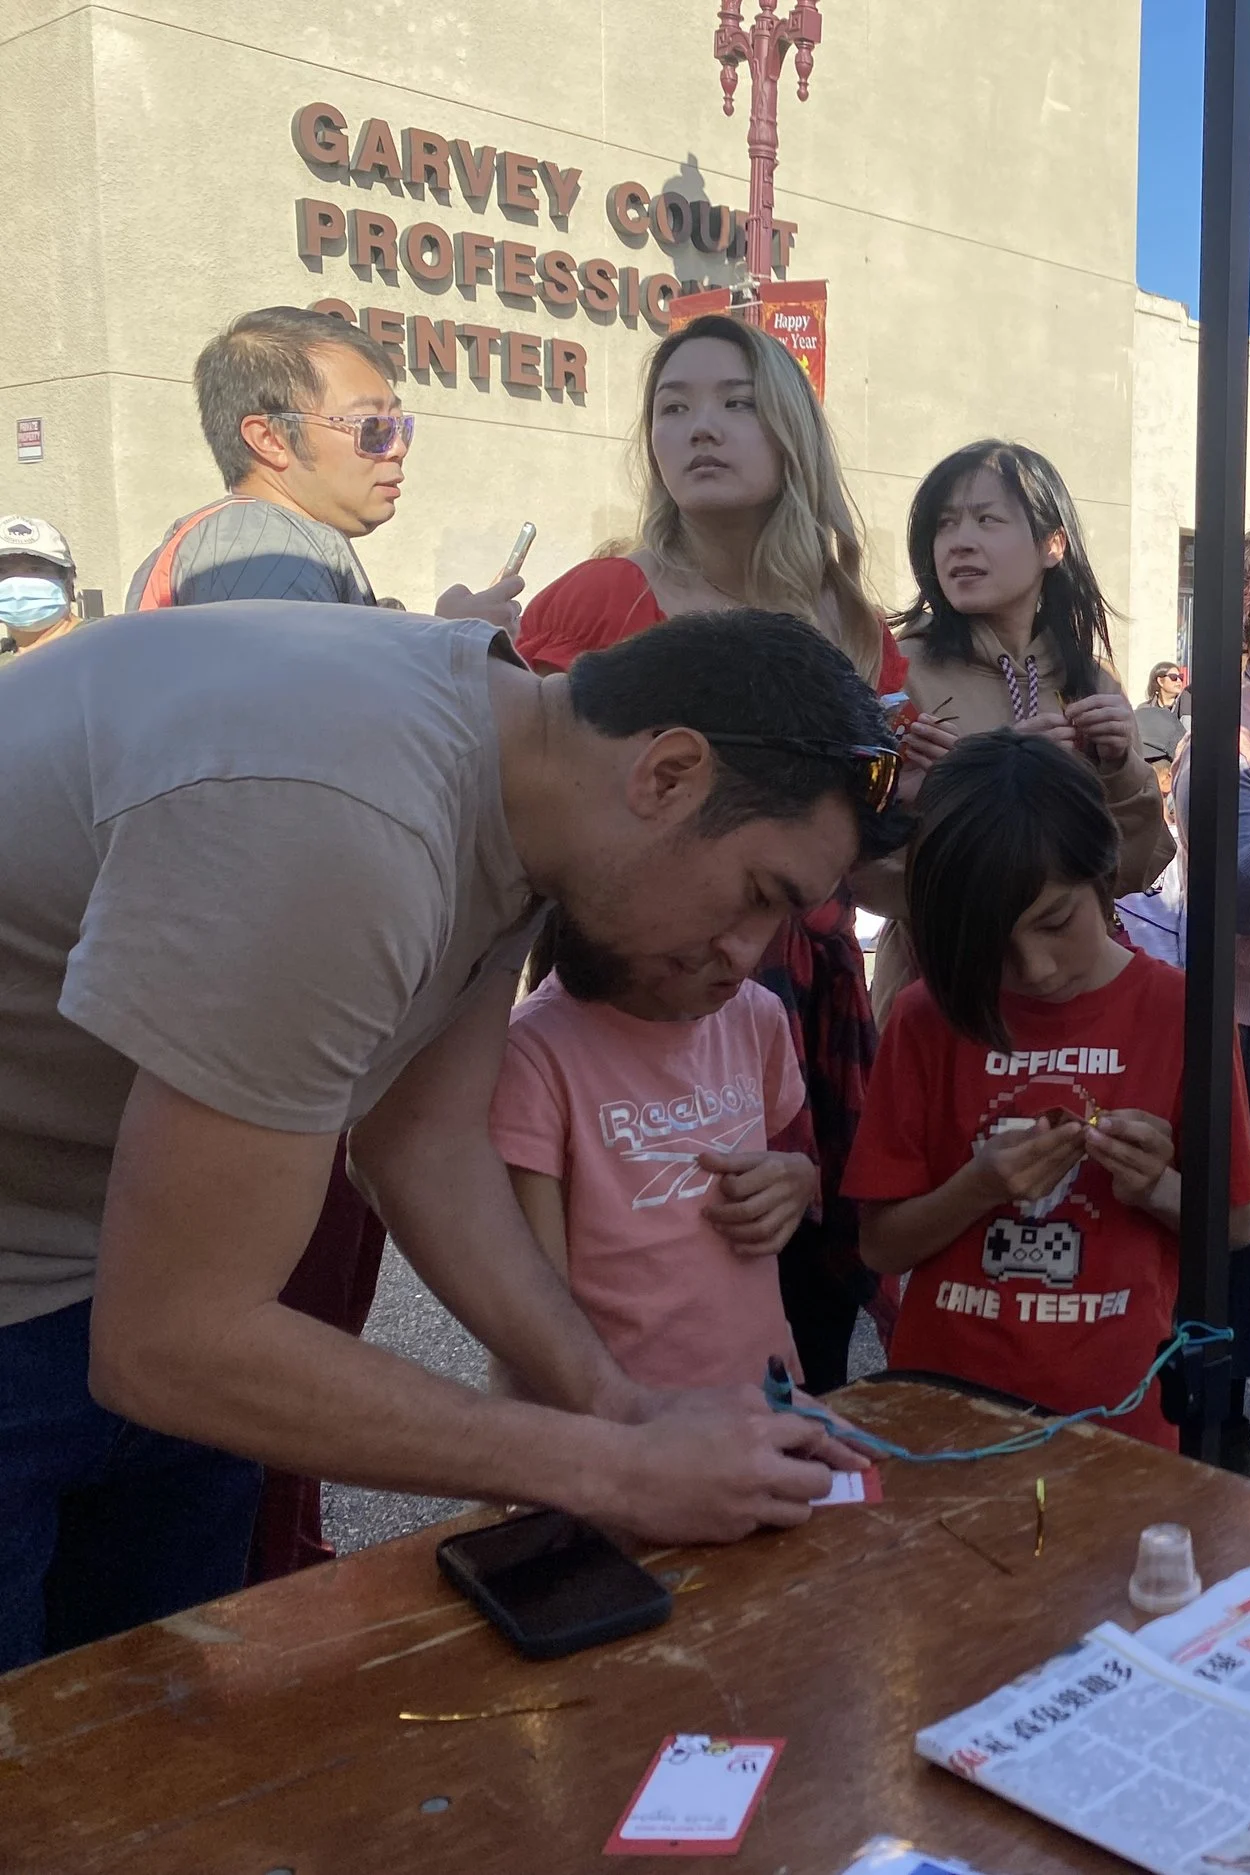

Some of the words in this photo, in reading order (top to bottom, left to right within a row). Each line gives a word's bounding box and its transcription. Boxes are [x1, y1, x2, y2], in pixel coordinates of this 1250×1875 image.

[291, 102, 583, 217] GARVEY
[295, 198, 722, 318] PROFESSIO
[774, 312, 811, 332] Happy
[791, 333, 818, 350] Year
[985, 1047, 1126, 1076] OFFICIAL
[598, 1073, 763, 1151] Reebok
[935, 1281, 1001, 1320] GAME
[1016, 1289, 1131, 1323] TESTER
